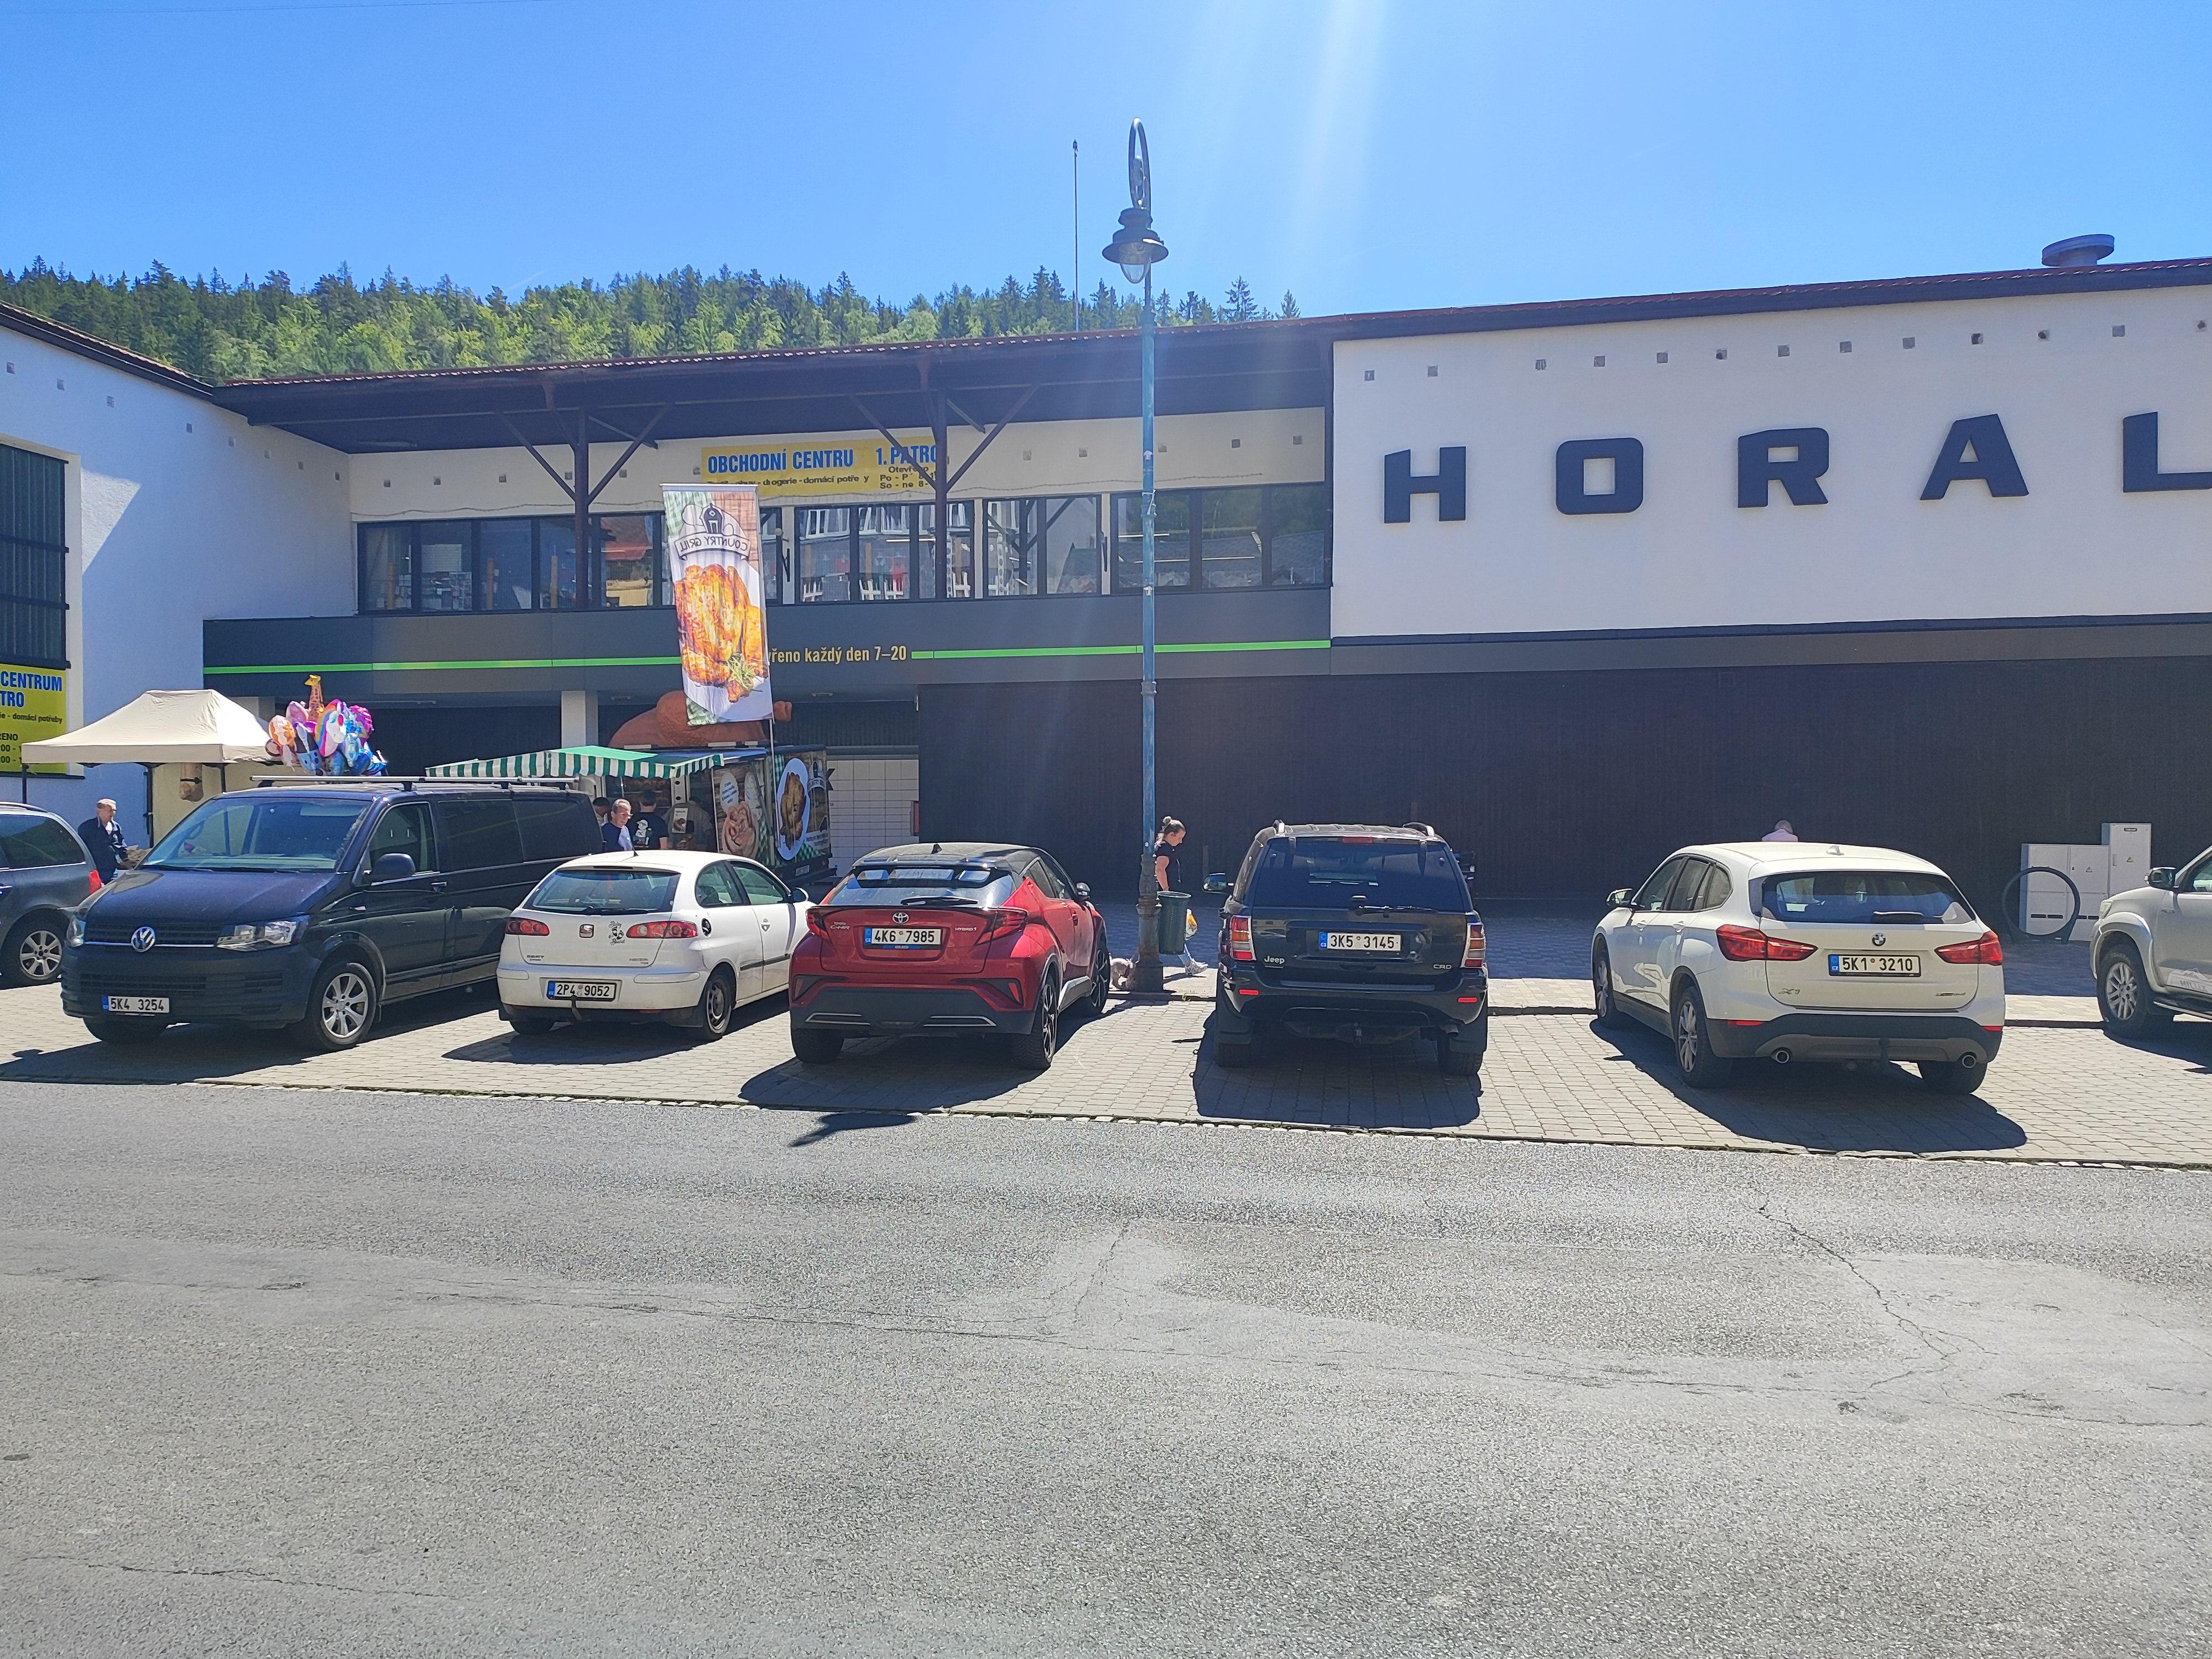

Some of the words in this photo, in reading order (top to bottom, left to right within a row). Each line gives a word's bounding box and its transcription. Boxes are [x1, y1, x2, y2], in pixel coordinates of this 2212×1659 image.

[708, 449, 786, 474] OBCHODNÍ
[792, 449, 853, 469] CENTRU
[1384, 411, 2212, 524] HORAL
[804, 474, 834, 484] domácí
[805, 646, 842, 665] každý
[846, 646, 869, 661] den
[1, 671, 62, 691] CENTRUM
[874, 930, 896, 943] 4K6
[905, 930, 935, 943] 7985
[1330, 935, 1354, 948] 3K5
[1363, 936, 1395, 949] 3145
[1264, 956, 1285, 964] Jeep
[1842, 957, 1867, 971] 5K1
[1879, 958, 1913, 972] 3210
[556, 984, 576, 995] 2P4
[584, 985, 610, 997] 9052
[2180, 980, 2208, 993] HILUX
[111, 998, 130, 1010] 5K4
[138, 999, 164, 1011] 3254
